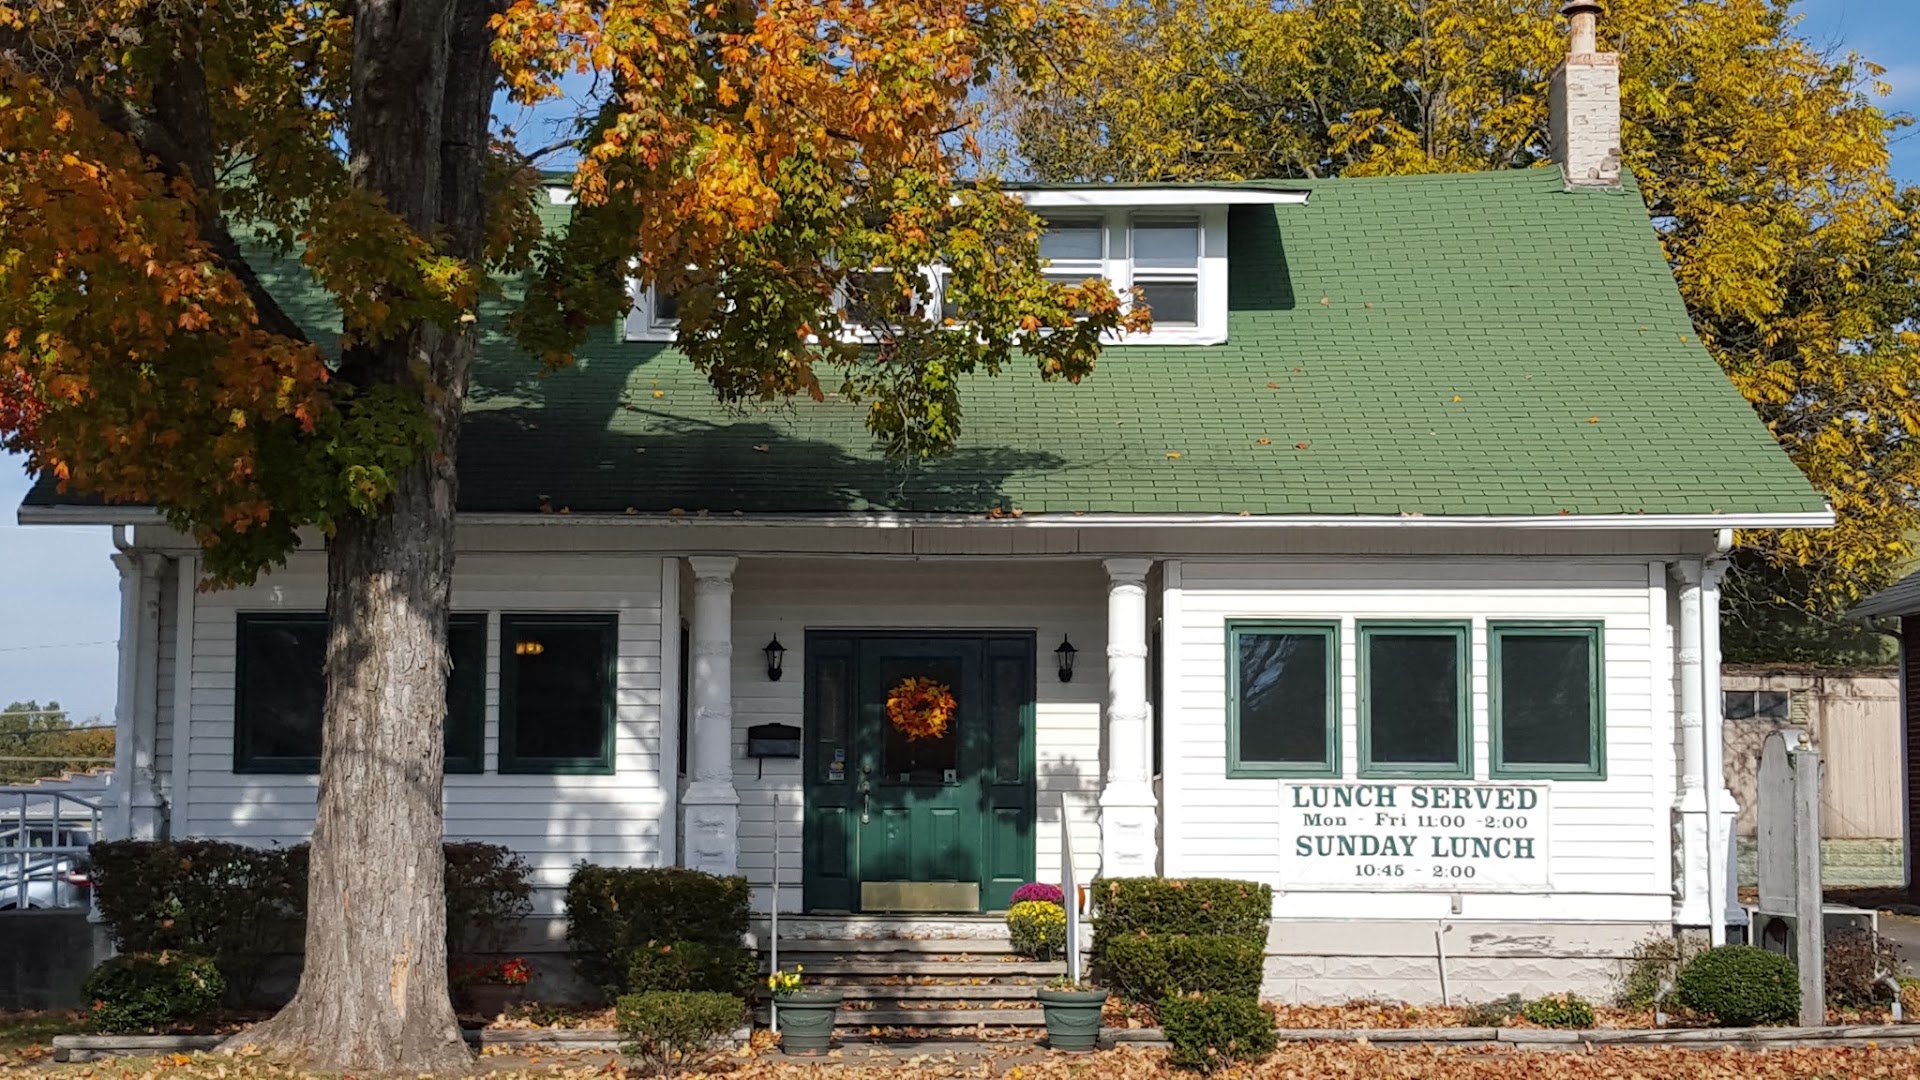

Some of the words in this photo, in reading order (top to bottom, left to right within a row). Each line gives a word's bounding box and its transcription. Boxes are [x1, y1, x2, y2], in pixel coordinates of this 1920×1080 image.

[1292, 785, 1397, 808] LUNCH
[1411, 785, 1538, 810] SERVED
[1303, 813, 1347, 827] Mon
[1375, 812, 1406, 827] Fri
[1296, 835, 1418, 857] SUNDAY
[1431, 836, 1536, 859] LUNCH
[1355, 864, 1405, 877] 10:45
[1432, 865, 1476, 878] 2:00
